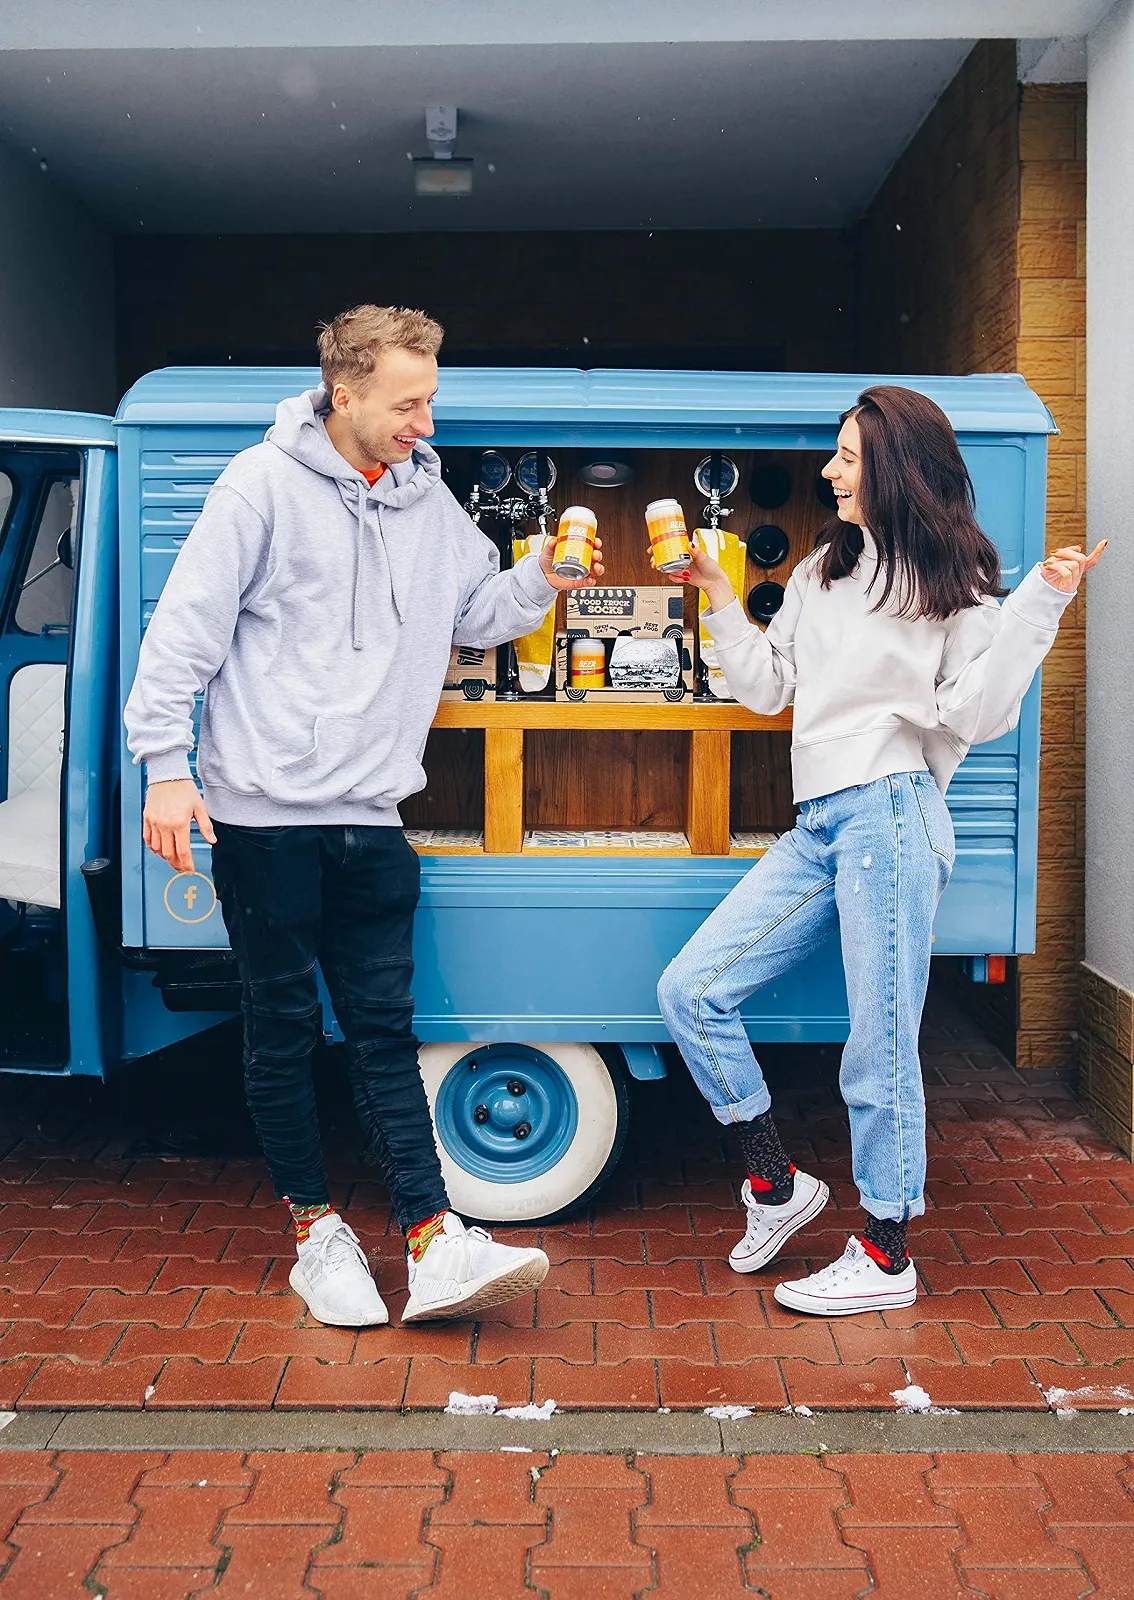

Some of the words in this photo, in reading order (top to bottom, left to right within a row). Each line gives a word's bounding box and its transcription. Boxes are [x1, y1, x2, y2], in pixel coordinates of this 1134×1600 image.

[587, 605, 624, 614] SOCKS
[578, 660, 596, 668] BEER
[184, 885, 197, 909] f
